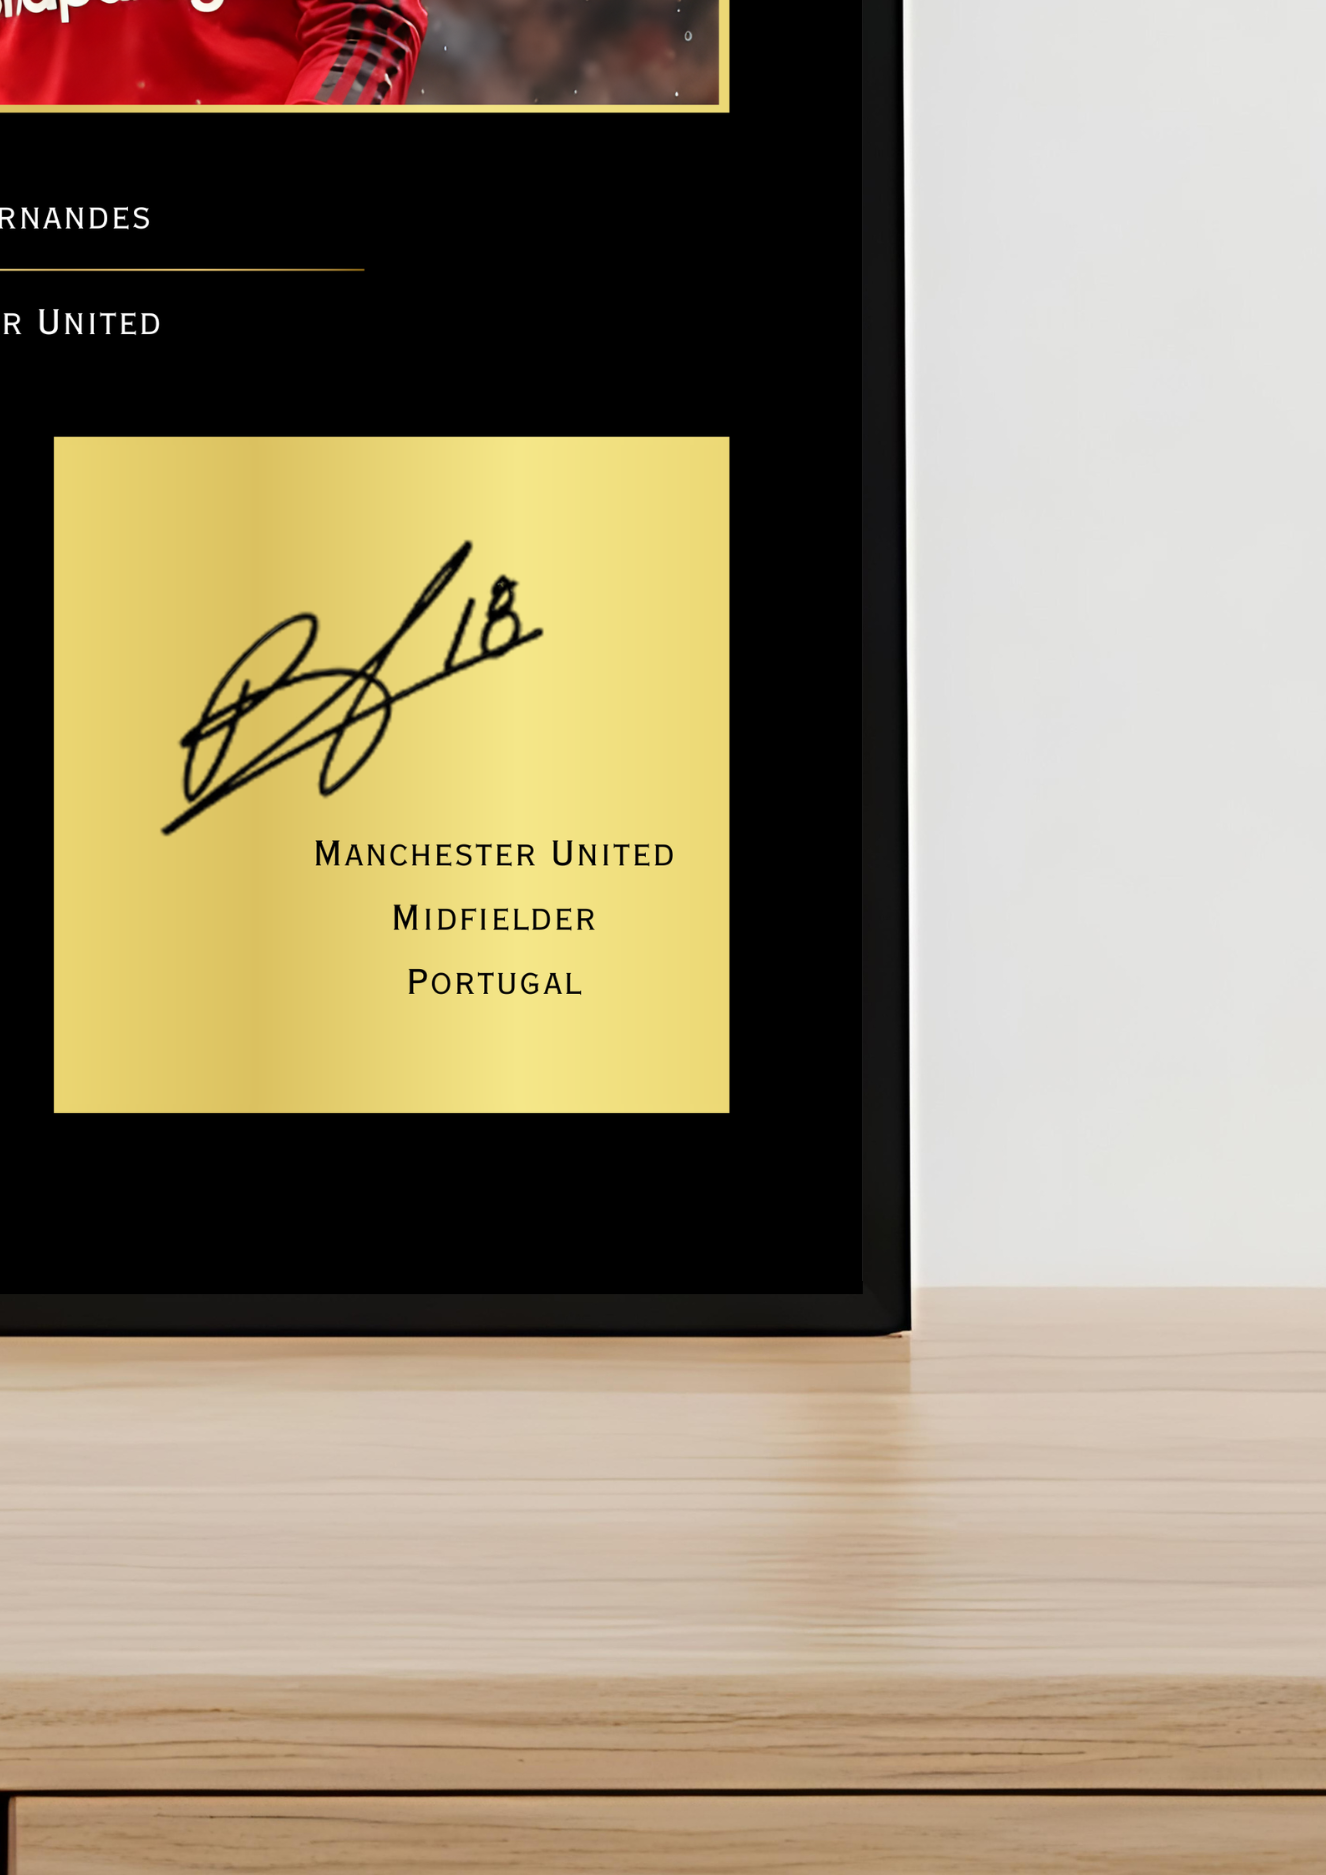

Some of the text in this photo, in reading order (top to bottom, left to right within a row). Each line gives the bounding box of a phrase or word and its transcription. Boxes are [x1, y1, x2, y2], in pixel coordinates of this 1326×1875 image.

[38, 308, 160, 336] UNITED
[315, 839, 674, 867] MANCHESTER UNITED
[393, 904, 595, 931] MIDFIELDER
[408, 968, 582, 995] PORTUGAL
